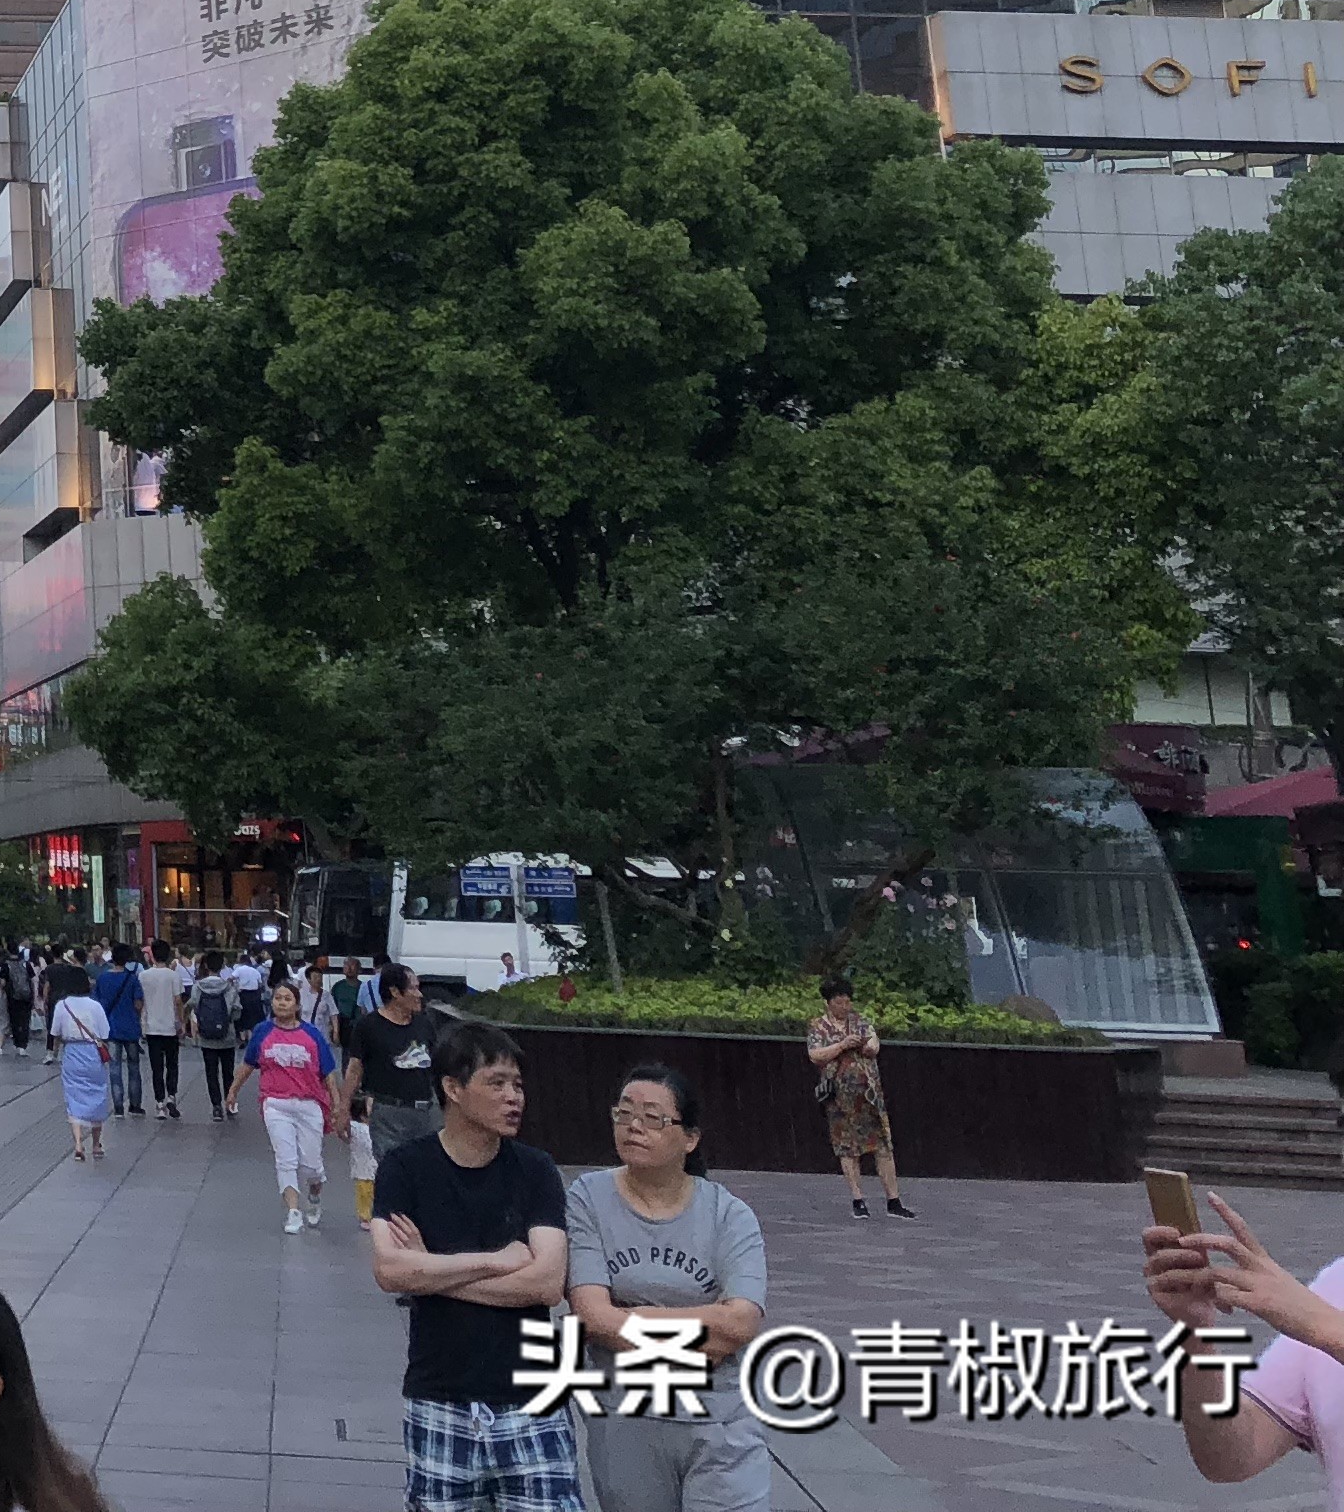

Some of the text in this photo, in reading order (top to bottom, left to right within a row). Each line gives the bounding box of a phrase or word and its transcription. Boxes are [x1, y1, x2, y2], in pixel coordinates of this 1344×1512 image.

[201, 4, 335, 64] 突破未来
[1060, 55, 1317, 98] SOFI
[606, 1246, 717, 1294] OOD PERSON
